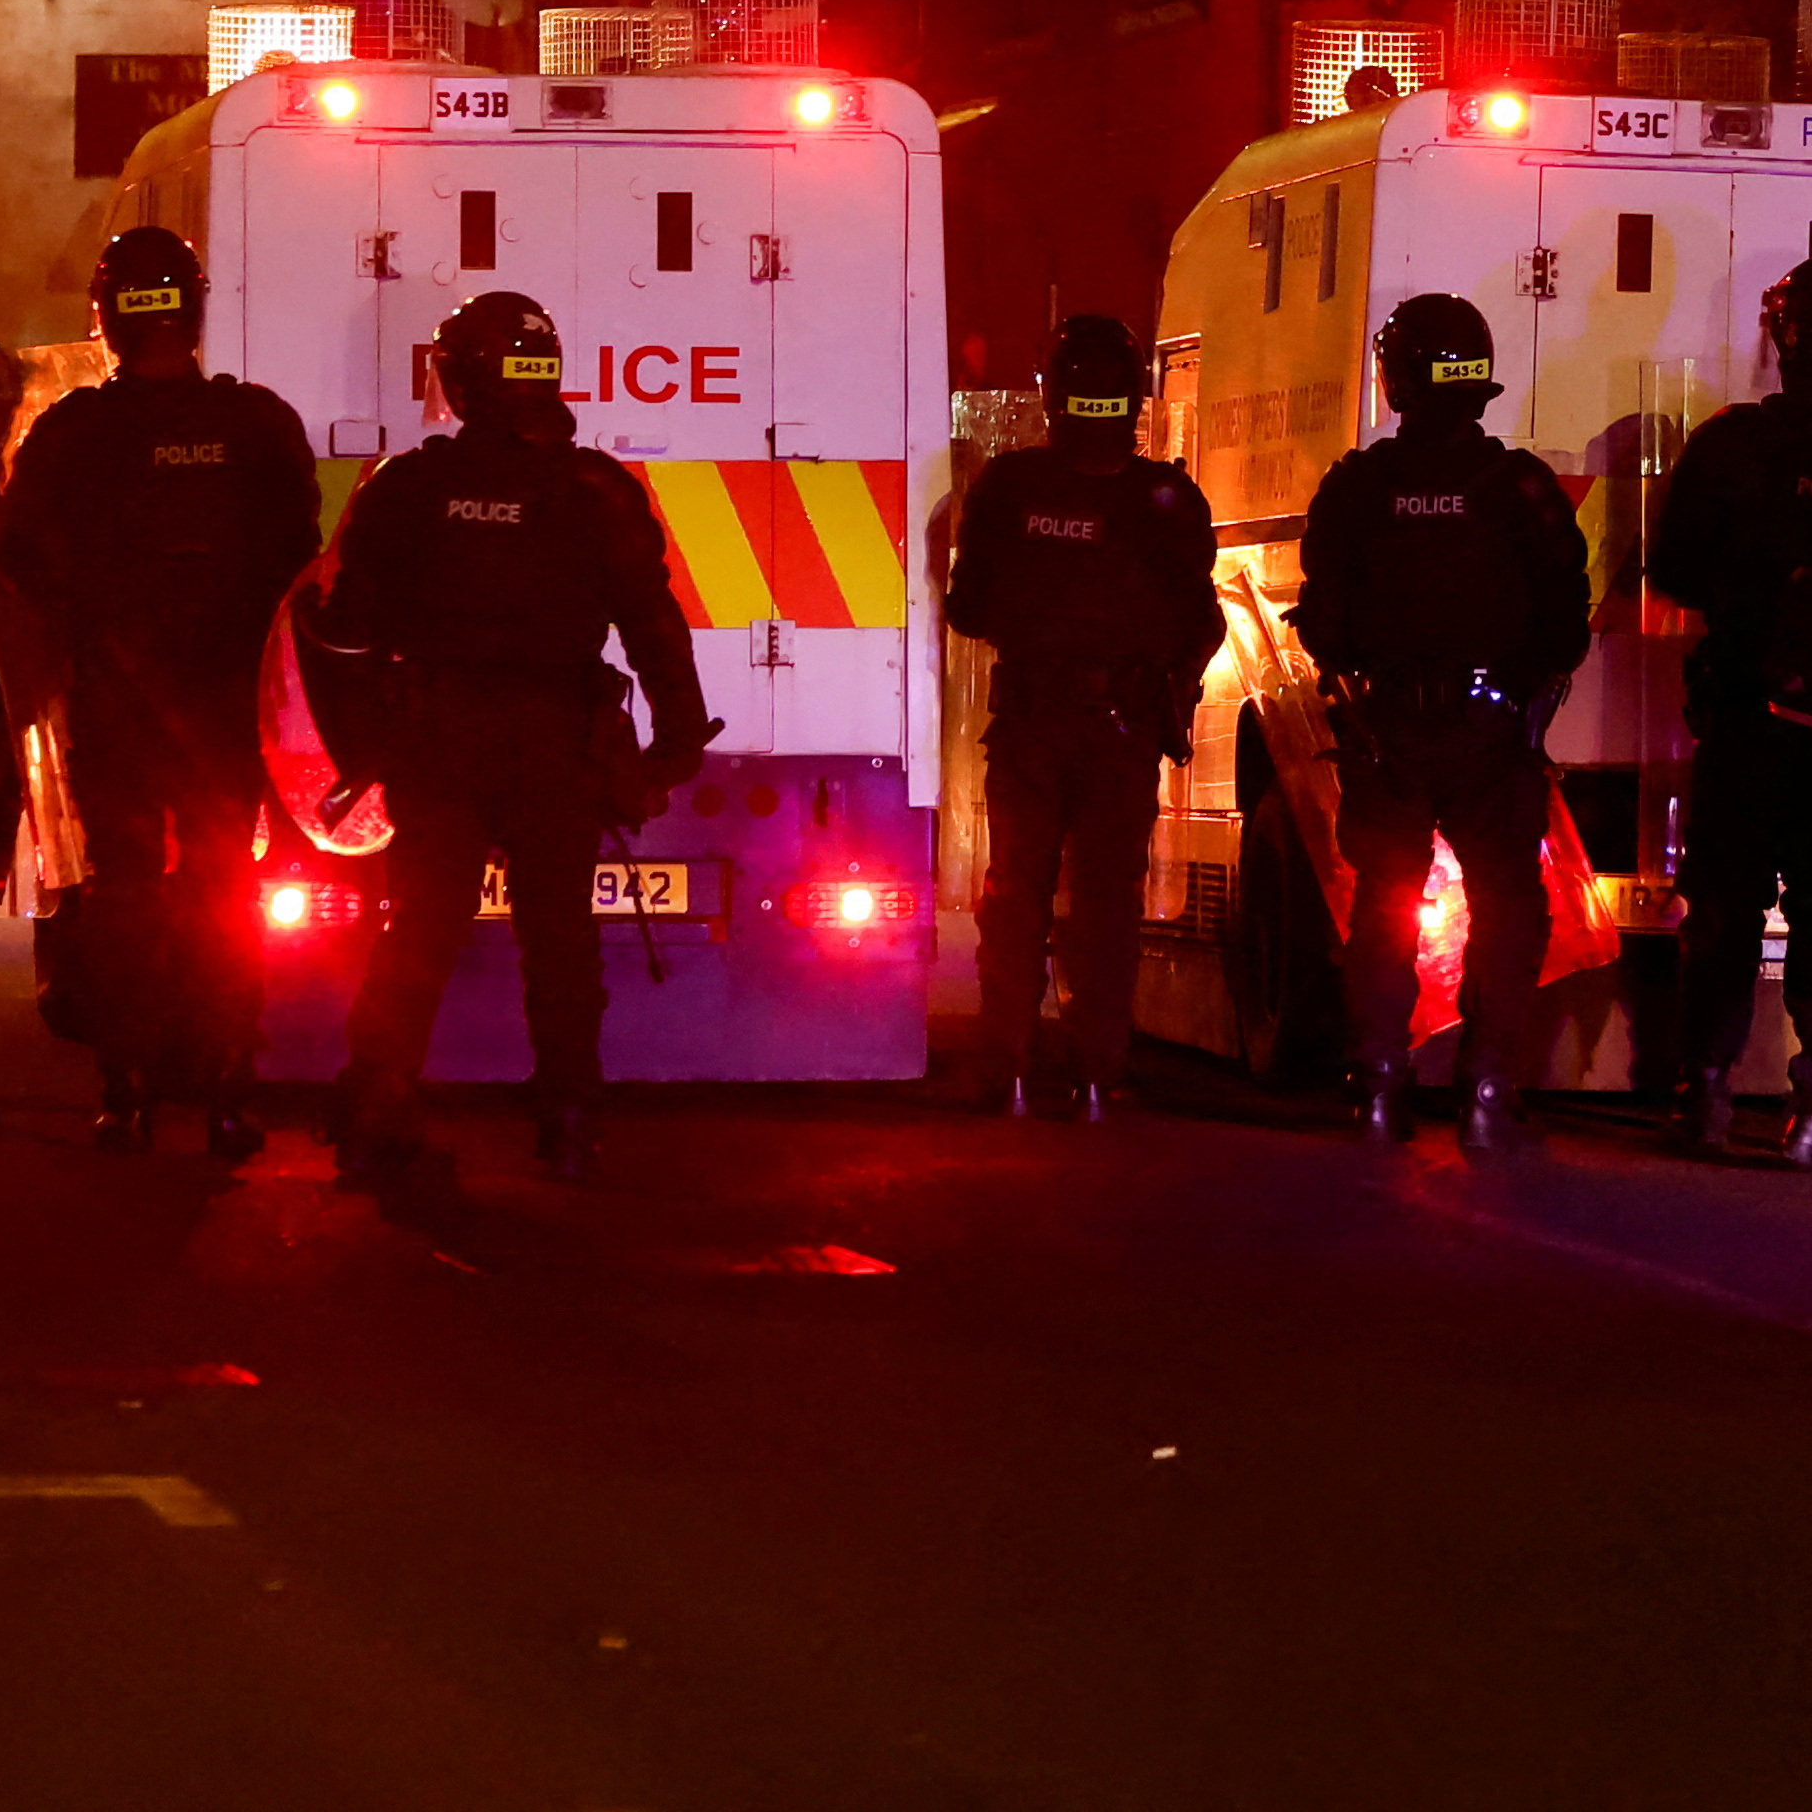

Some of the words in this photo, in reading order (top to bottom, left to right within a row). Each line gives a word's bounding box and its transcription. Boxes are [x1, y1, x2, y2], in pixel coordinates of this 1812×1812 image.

[437, 92, 508, 118] S43B
[1597, 110, 1669, 138] S43C
[1442, 364, 1484, 378] S43-C
[154, 444, 226, 466] POLICE
[448, 499, 522, 524] POLICE
[1395, 496, 1464, 516] POLICE
[1028, 515, 1094, 540] POLICE
